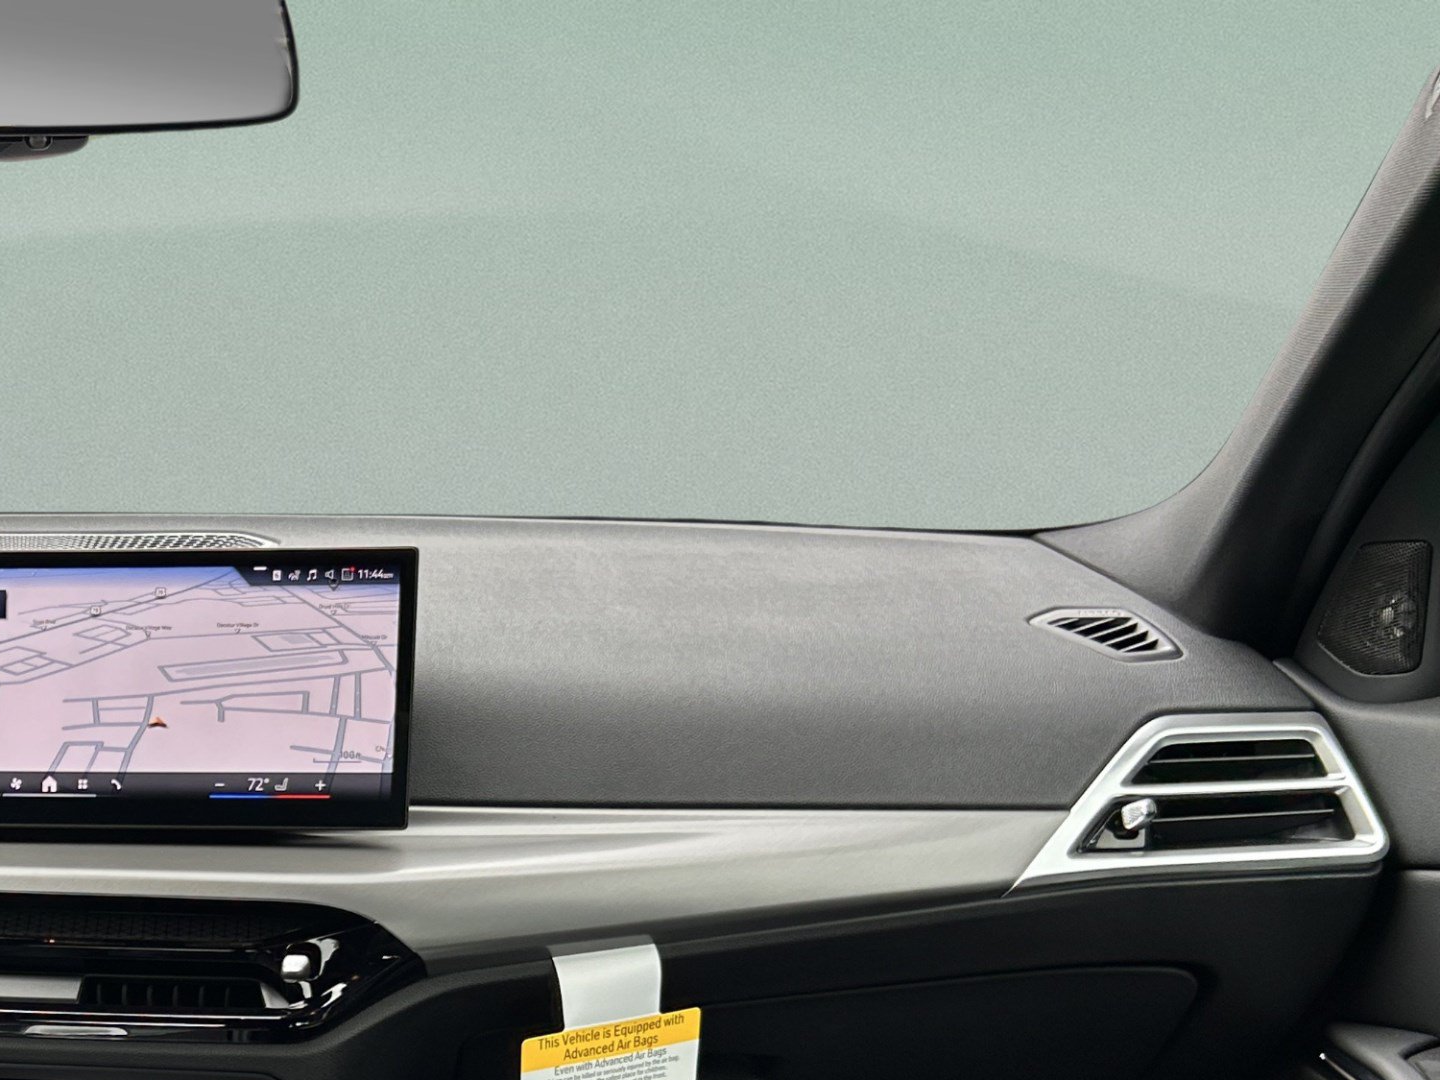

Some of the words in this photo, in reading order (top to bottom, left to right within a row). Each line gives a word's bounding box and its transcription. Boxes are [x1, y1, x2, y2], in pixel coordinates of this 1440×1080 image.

[538, 1038, 560, 1050] This
[562, 1029, 600, 1047] Vehicle
[602, 1027, 611, 1038] is
[614, 1019, 661, 1037] Equipped
[663, 1013, 685, 1026] with
[563, 1040, 615, 1061] Advanced
[617, 1038, 632, 1051] Air
[634, 1034, 659, 1049] Bags
[554, 1066, 574, 1076] Even
[576, 1061, 593, 1071] with
[595, 1053, 633, 1068] Advanced
[634, 1051, 646, 1060] Air
[647, 1048, 667, 1058] Bags
